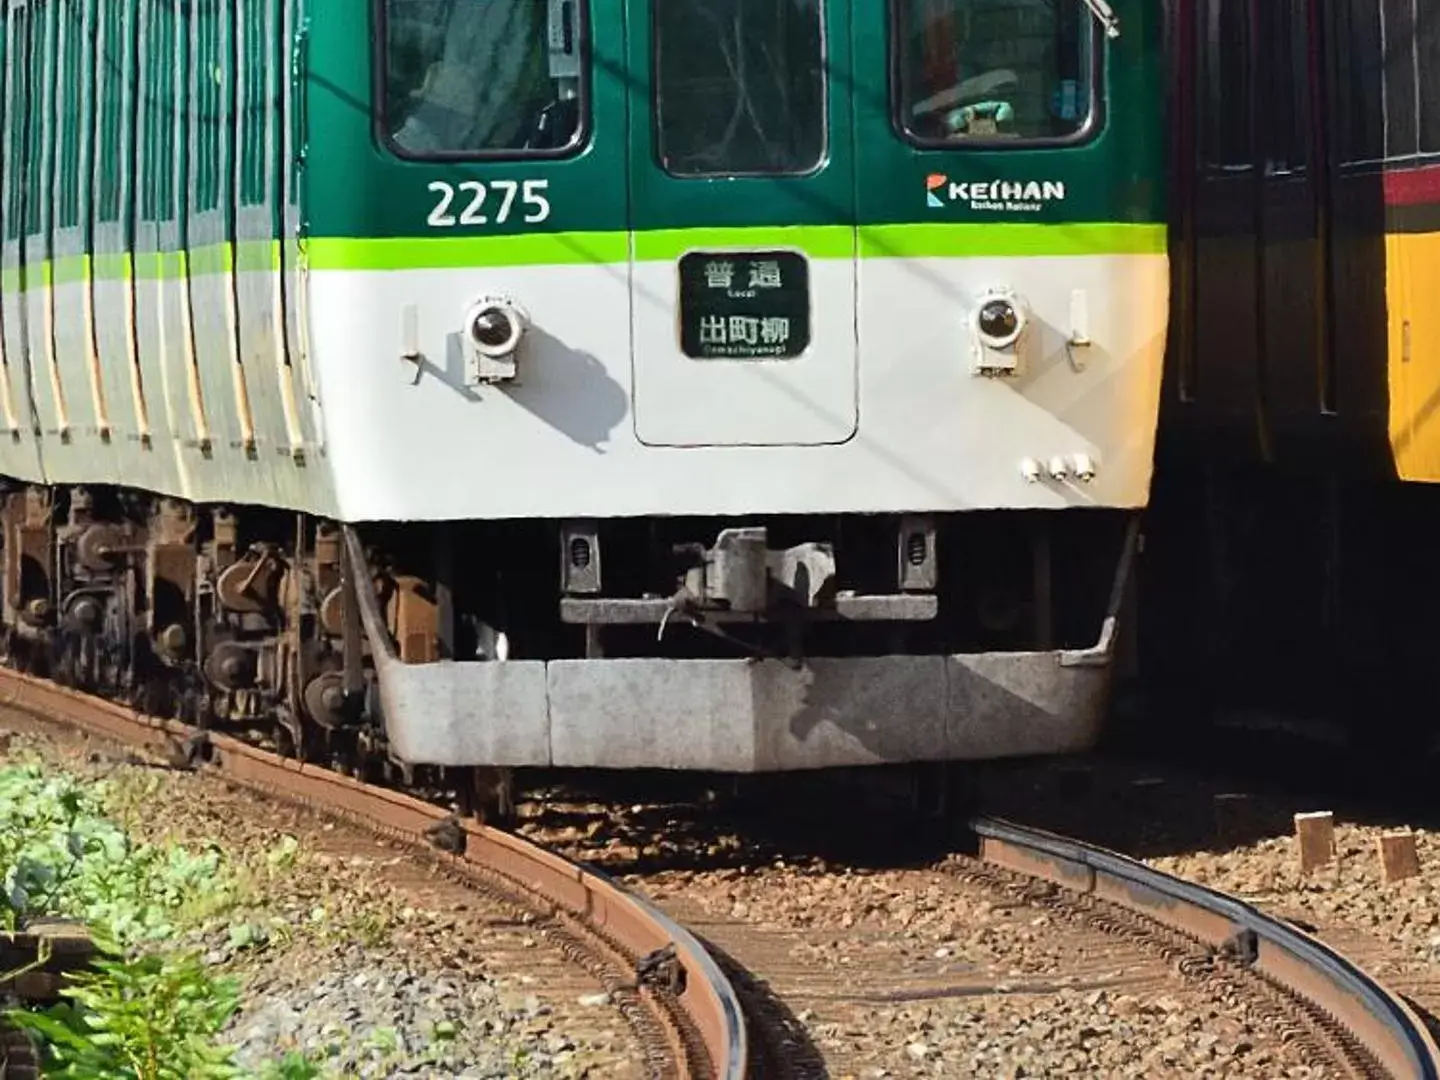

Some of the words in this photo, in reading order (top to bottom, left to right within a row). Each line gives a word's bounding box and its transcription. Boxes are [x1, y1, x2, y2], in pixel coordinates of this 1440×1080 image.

[427, 179, 550, 226] 2275
[949, 180, 1065, 200] KEIHAN
[704, 260, 782, 288] 普通
[700, 315, 789, 344] 出町柳
